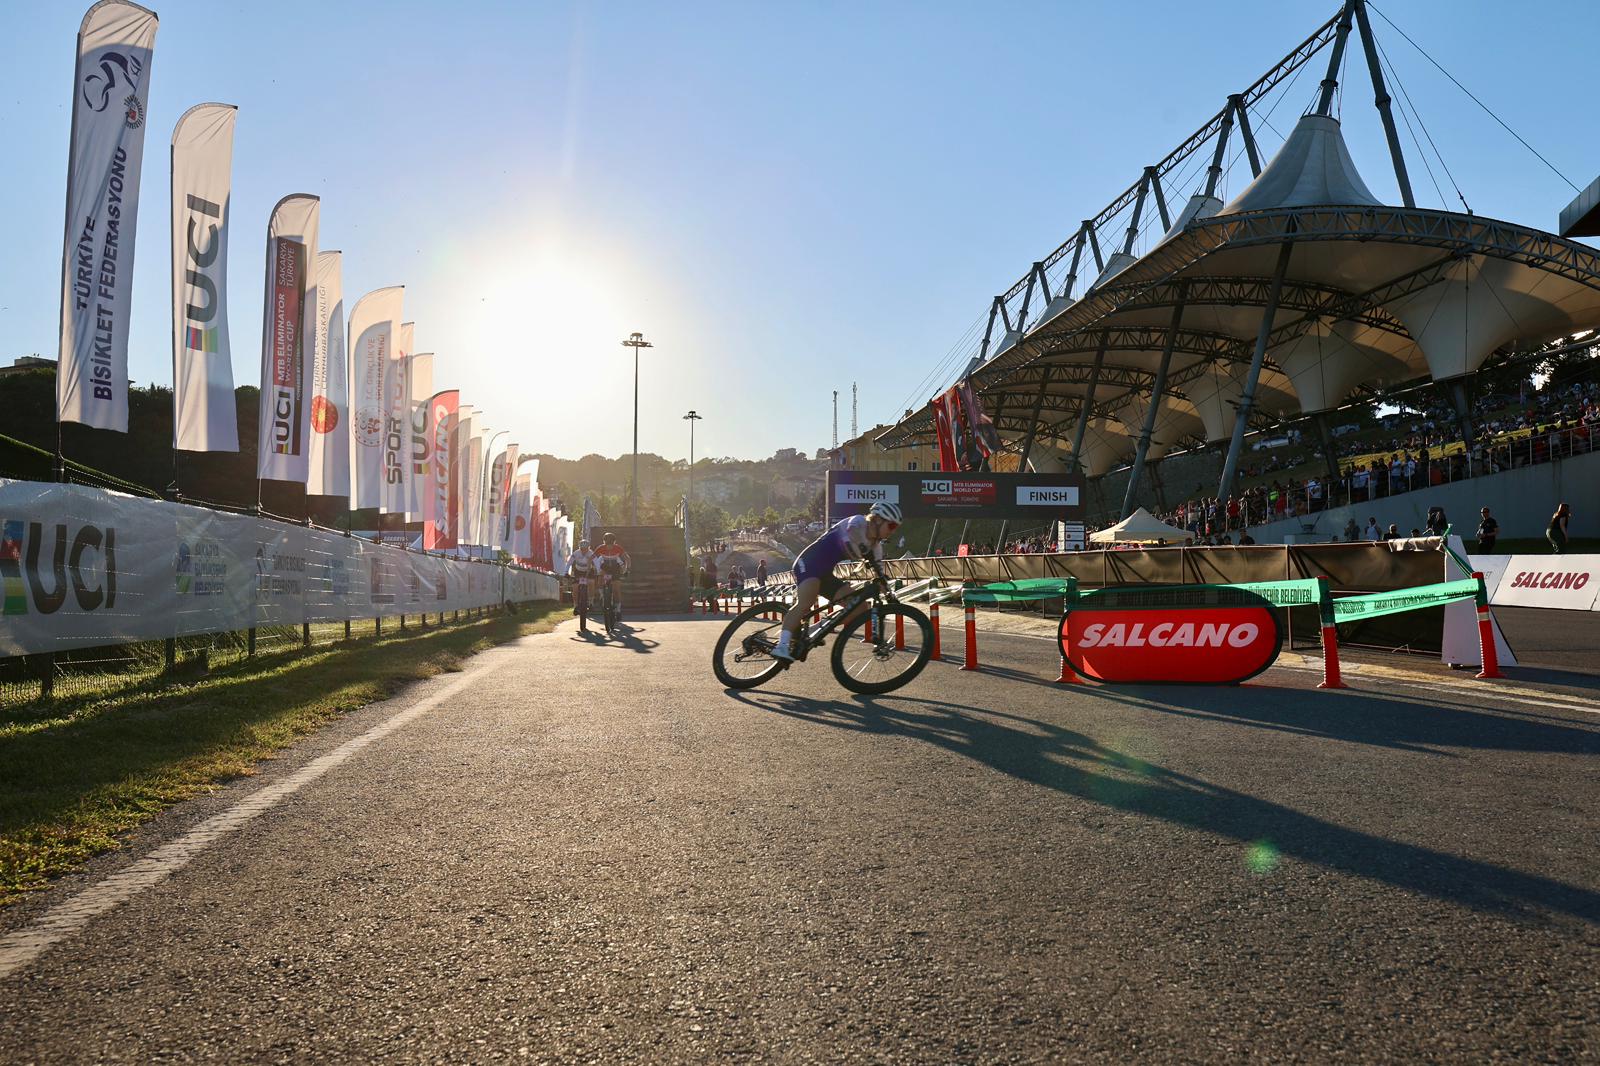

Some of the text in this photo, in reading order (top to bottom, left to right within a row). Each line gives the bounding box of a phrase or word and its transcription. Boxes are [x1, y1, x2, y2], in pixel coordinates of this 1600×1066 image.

[74, 216, 96, 311] TÜRKİYE
[89, 147, 127, 401] BİSİKLET FEDERASYONU
[186, 194, 220, 323] UCI
[278, 241, 288, 286] SAKARYA
[277, 293, 286, 382] MTB ELIMINATOR
[284, 320, 295, 383] WORLD CUP
[276, 391, 291, 442] UCI
[386, 416, 403, 485] SPOR
[434, 404, 449, 540] SALCANO
[490, 463, 503, 504] UCI
[847, 489, 886, 500] FINISH
[927, 482, 950, 492] UCI
[1029, 491, 1068, 502] FINISH
[25, 522, 116, 615] UCI
[1510, 571, 1590, 590] SALCANO
[1077, 622, 1260, 648] SALCANO
